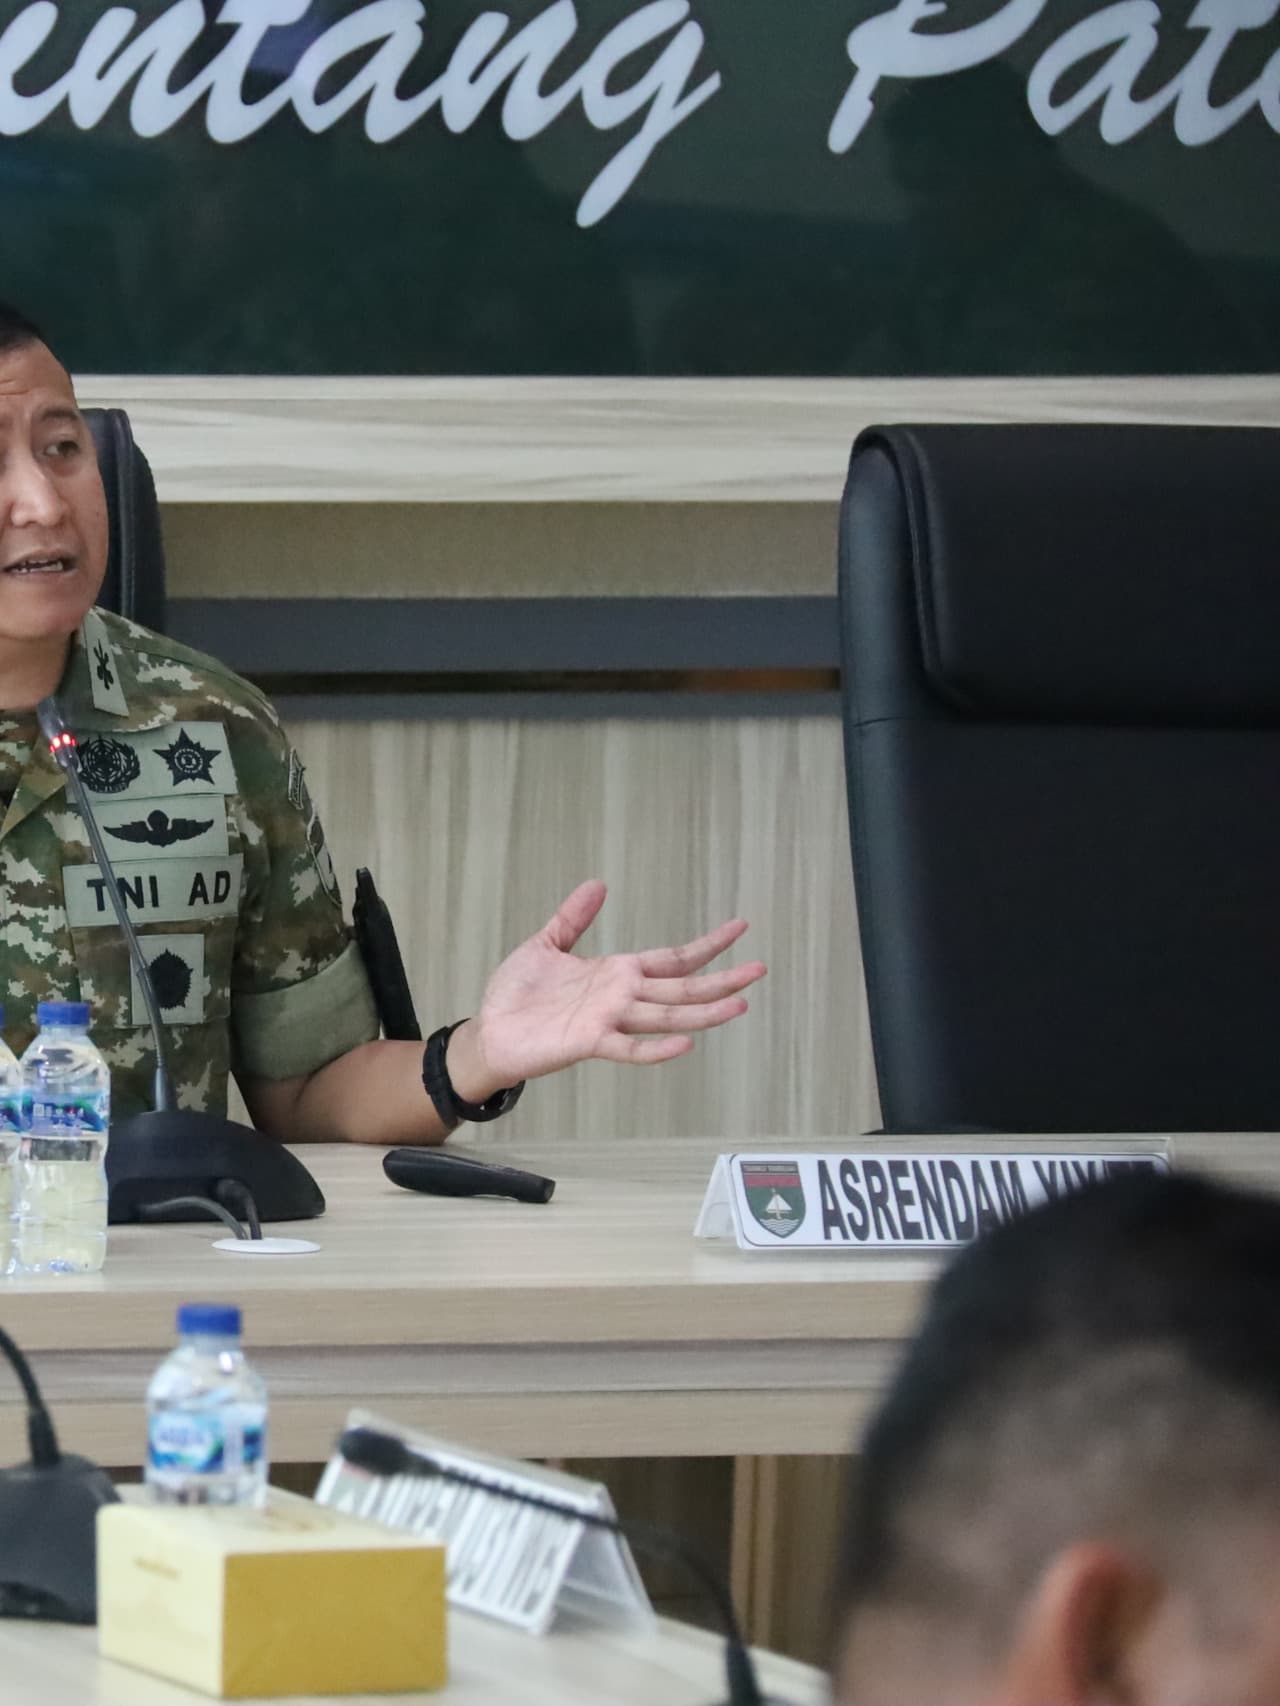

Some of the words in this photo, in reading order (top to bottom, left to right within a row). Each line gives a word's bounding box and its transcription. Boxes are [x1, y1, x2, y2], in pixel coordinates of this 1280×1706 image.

[86, 874, 160, 912] TNI
[187, 870, 232, 907] AD
[817, 1158, 1032, 1242] ASRENDAM
